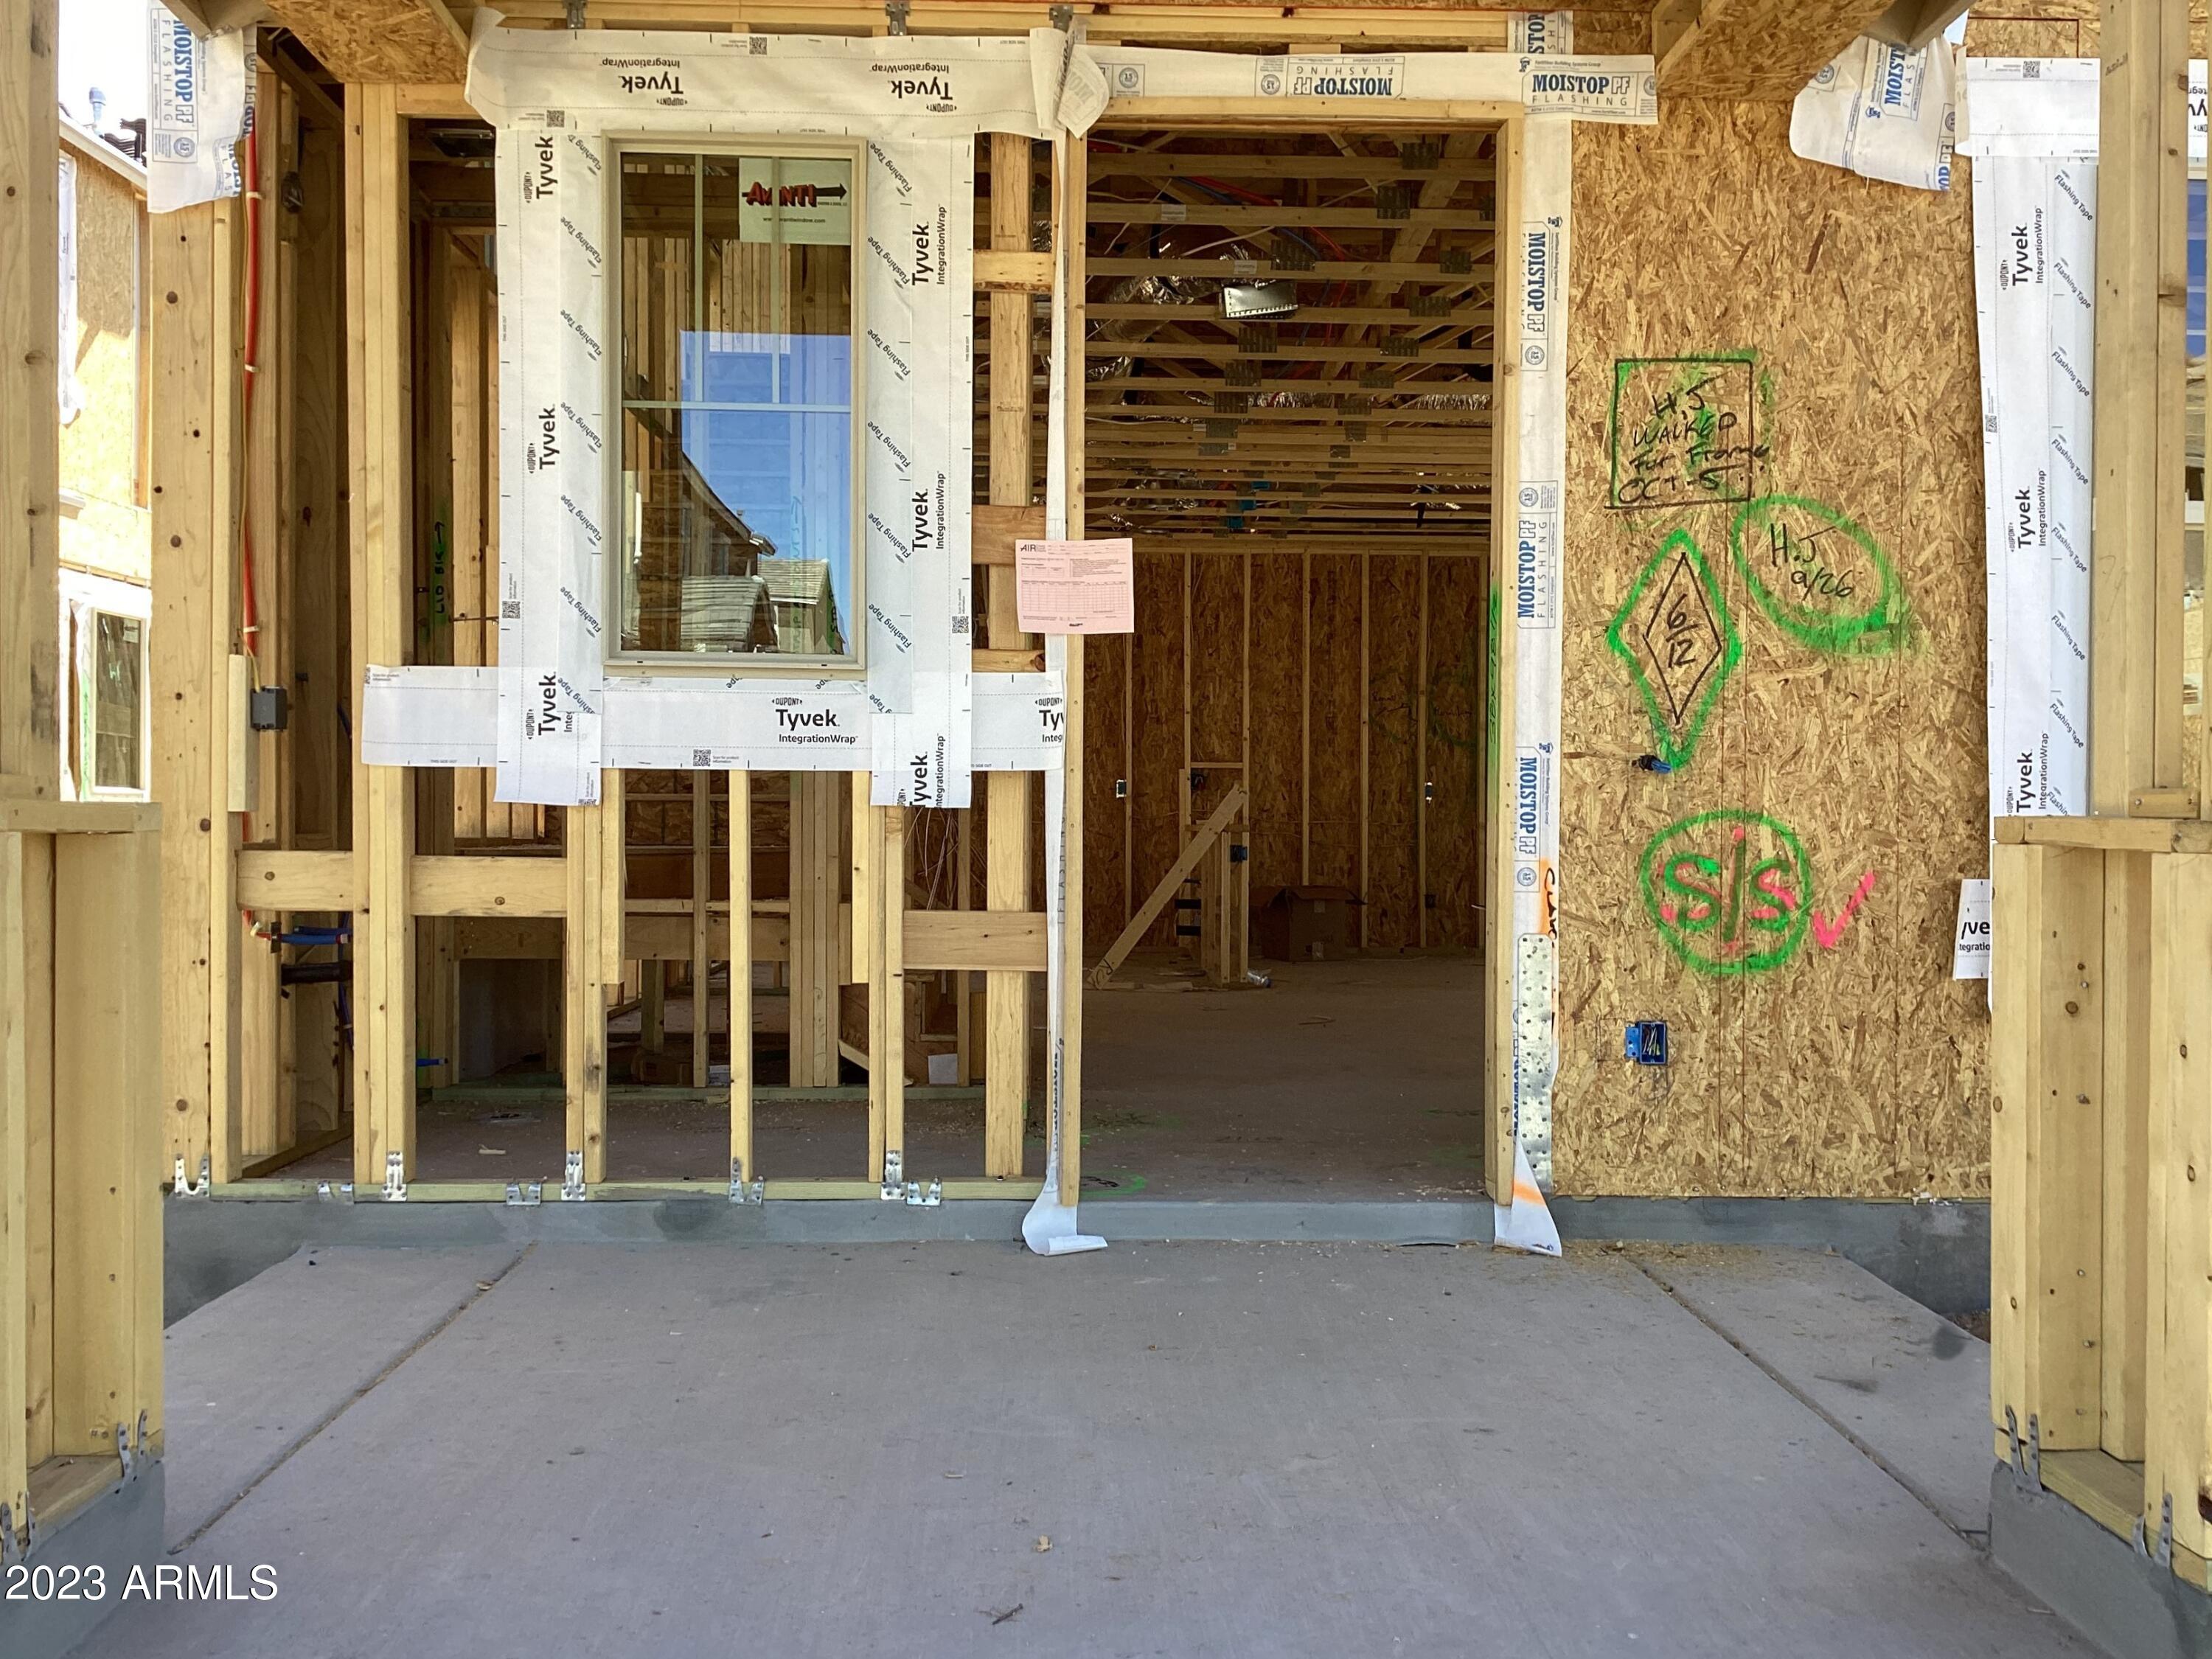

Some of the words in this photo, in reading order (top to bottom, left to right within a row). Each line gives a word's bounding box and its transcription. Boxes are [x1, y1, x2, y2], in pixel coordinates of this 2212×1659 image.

[162, 20, 173, 121] FLASHING
[173, 20, 193, 102] MOISTOP
[602, 58, 681, 69] IntegrationWrap
[872, 63, 950, 74] IntegrationWrap
[1296, 66, 1394, 75] FLASHING
[621, 72, 684, 94] Tyvek
[891, 77, 953, 100] Tyvek
[1314, 77, 1394, 96] MOISTOP
[1532, 74, 1610, 94] MOISTOP
[1532, 94, 1627, 106] FLASHING
[535, 135, 558, 199] Tyvek
[870, 143, 884, 164] Tape
[885, 160, 913, 192] Flashing
[2054, 174, 2079, 205] Flashing
[2077, 201, 2093, 221] Tape
[560, 216, 578, 236] Tape
[575, 232, 602, 264] Flashing
[867, 236, 883, 256] Tape
[912, 223, 933, 286] Tyvek
[937, 207, 947, 285] IntegrationWrap
[2012, 225, 2033, 286] Tyvek
[2035, 207, 2045, 284] IntegrationWrap
[883, 252, 911, 285] Flashing
[1527, 232, 1545, 312] MOISTOP
[2053, 262, 2079, 293] Flashing
[2076, 289, 2091, 310] Tape
[560, 310, 577, 329] Tape
[575, 325, 602, 356] Flashing
[867, 329, 883, 349] Tape
[883, 345, 911, 377] Flashing
[2051, 351, 2076, 382] Flashing
[2075, 378, 2090, 397] Tape
[560, 402, 576, 421] Tape
[538, 408, 560, 470] Tyvek
[576, 417, 602, 449] Flashing
[867, 421, 883, 441] Tape
[883, 437, 911, 468] Flashing
[2051, 439, 2076, 470] Flashing
[2073, 466, 2089, 485] Tape
[561, 495, 577, 514] Tape
[936, 473, 946, 549] IntegrationWrap
[2014, 488, 2036, 549] Tyvek
[2038, 470, 2048, 547] IntegrationWrap
[575, 510, 602, 542] Flashing
[868, 512, 884, 532] Tape
[912, 491, 933, 552] Tyvek
[883, 528, 911, 559] Flashing
[2051, 527, 2075, 558] Flashing
[2072, 554, 2087, 573] Tape
[1517, 540, 1536, 619] MOISTOP
[1537, 521, 1548, 618] FLASHING
[1791, 567, 1854, 602] 9/26
[560, 586, 576, 605] Tape
[574, 601, 602, 633] Flashing
[869, 603, 885, 622] Tape
[884, 618, 912, 648] Flashing
[2051, 614, 2074, 645] Flashing
[2070, 641, 2086, 661] Tape
[1668, 639, 1697, 669] 12
[557, 678, 573, 697] Tape
[776, 697, 799, 706] DUPONT
[538, 674, 561, 736] Tyvek
[776, 709, 837, 731] Tyvek
[779, 734, 856, 745] IntegrationWrap
[2050, 703, 2073, 734] Flashing
[2069, 730, 2084, 748] Tape
[2016, 751, 2036, 813] Tyvek
[2039, 733, 2049, 810] IntegrationWrap
[1519, 757, 1537, 834] MOISTOP
